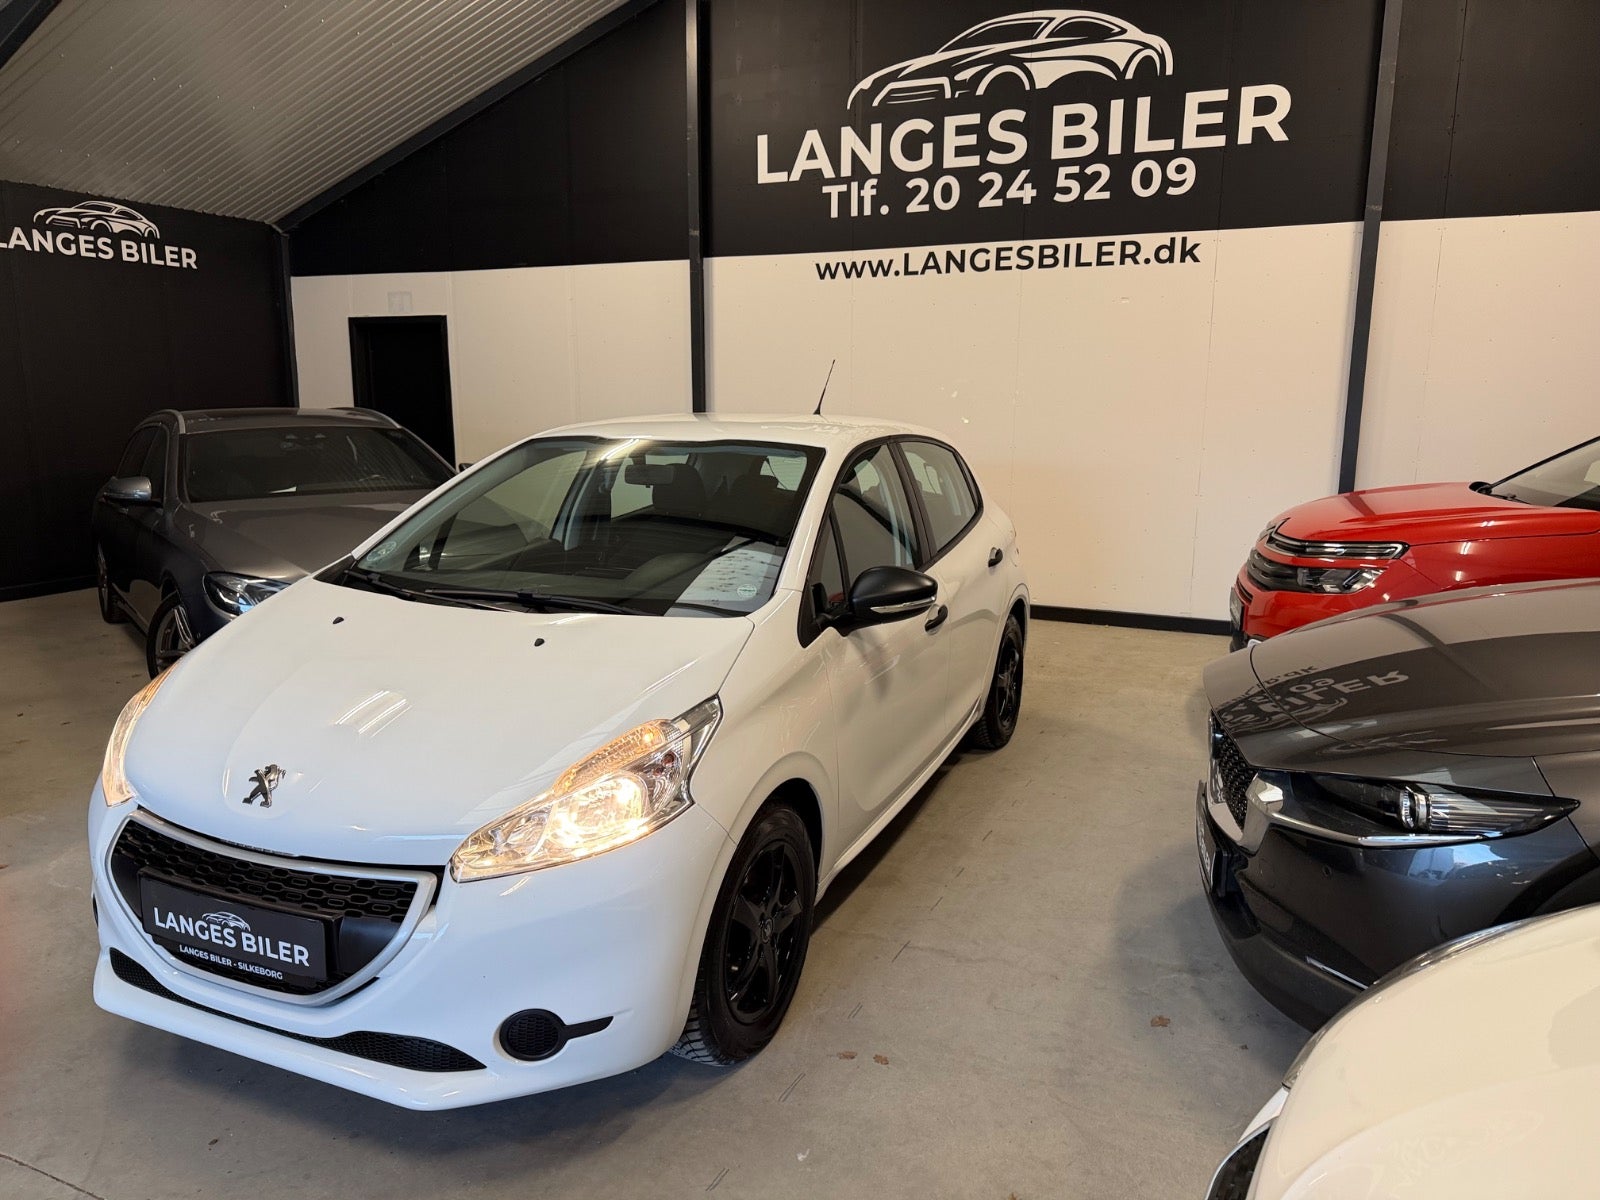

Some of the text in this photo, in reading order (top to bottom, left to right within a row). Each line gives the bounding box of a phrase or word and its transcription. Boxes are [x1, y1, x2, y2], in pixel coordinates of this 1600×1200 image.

[756, 83, 1292, 185] LANGES BILER
[821, 156, 1197, 219] Tlf. 20 24 52 09
[120, 239, 198, 270] BILER
[815, 236, 1201, 281] www.LANGESBILER.dk
[153, 906, 310, 967] LANGES BILER
[178, 943, 209, 960] LANGES
[209, 953, 232, 967] BILER
[237, 960, 283, 980] SILKEBORG
